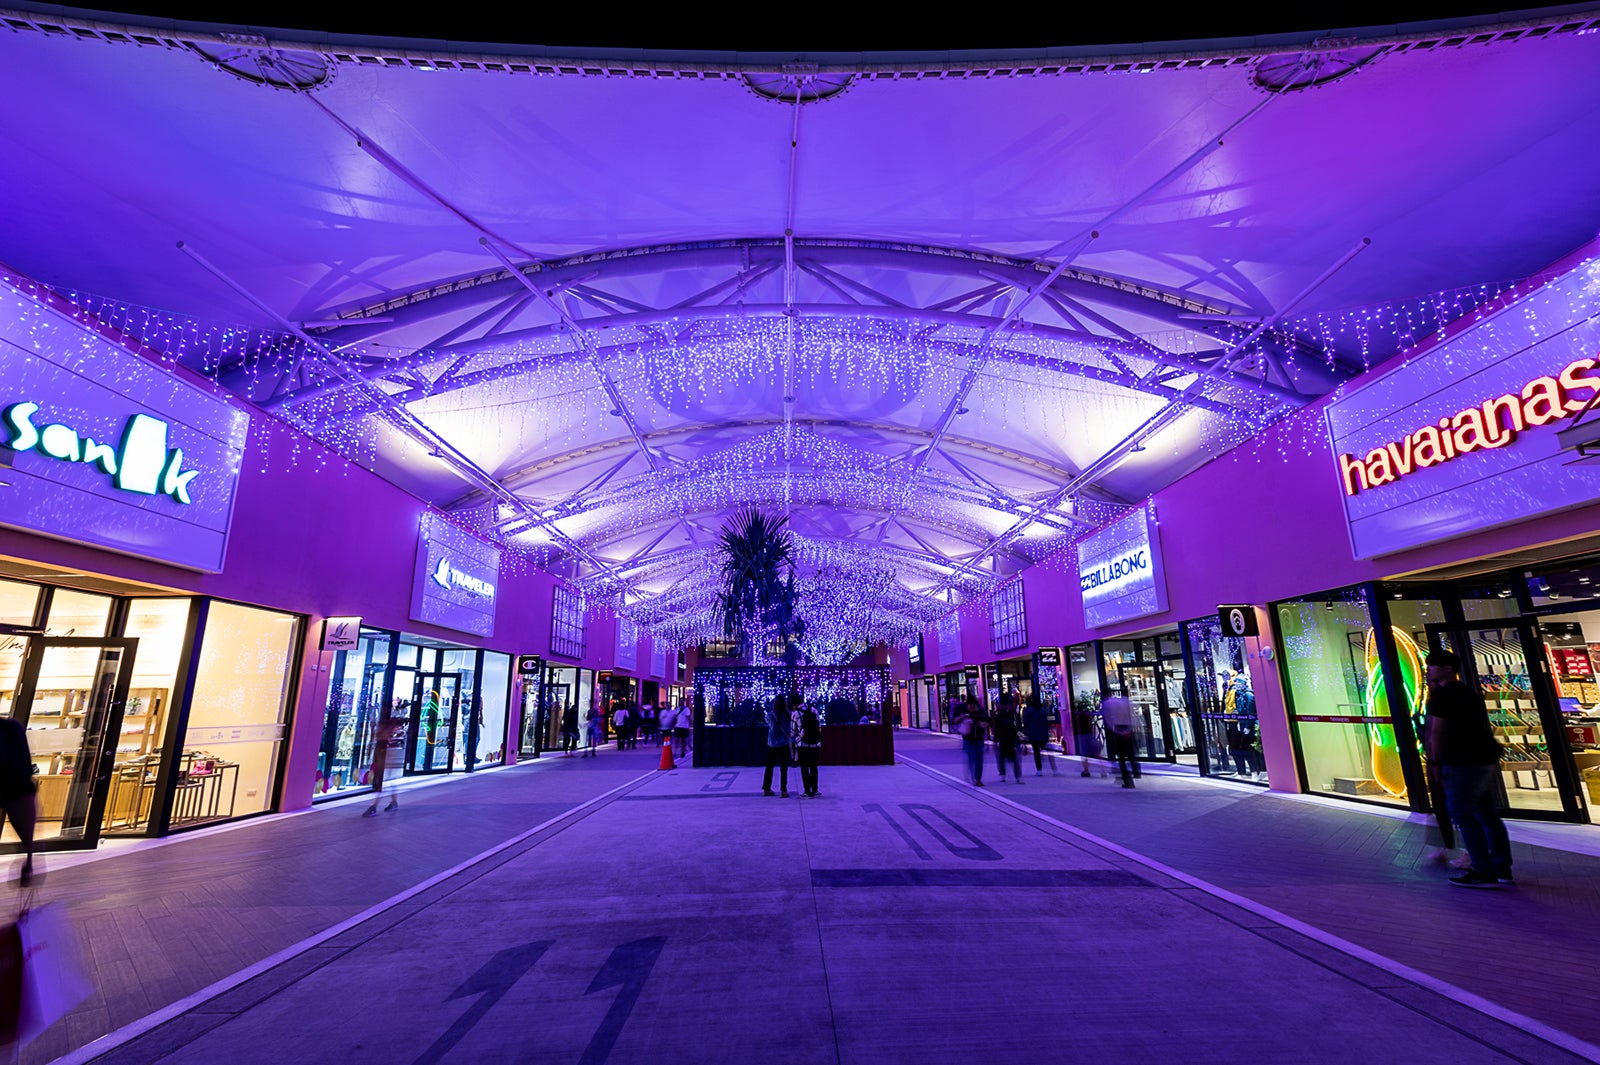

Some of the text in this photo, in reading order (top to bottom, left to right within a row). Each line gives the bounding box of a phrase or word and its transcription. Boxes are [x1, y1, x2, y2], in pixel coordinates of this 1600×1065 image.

[1339, 357, 1600, 496] havaianas
[449, 568, 495, 598] TRAVELER
[1090, 550, 1147, 589] BILLABONG
[700, 771, 741, 793] 9
[861, 803, 1005, 862] 10
[411, 935, 669, 1065] 11
